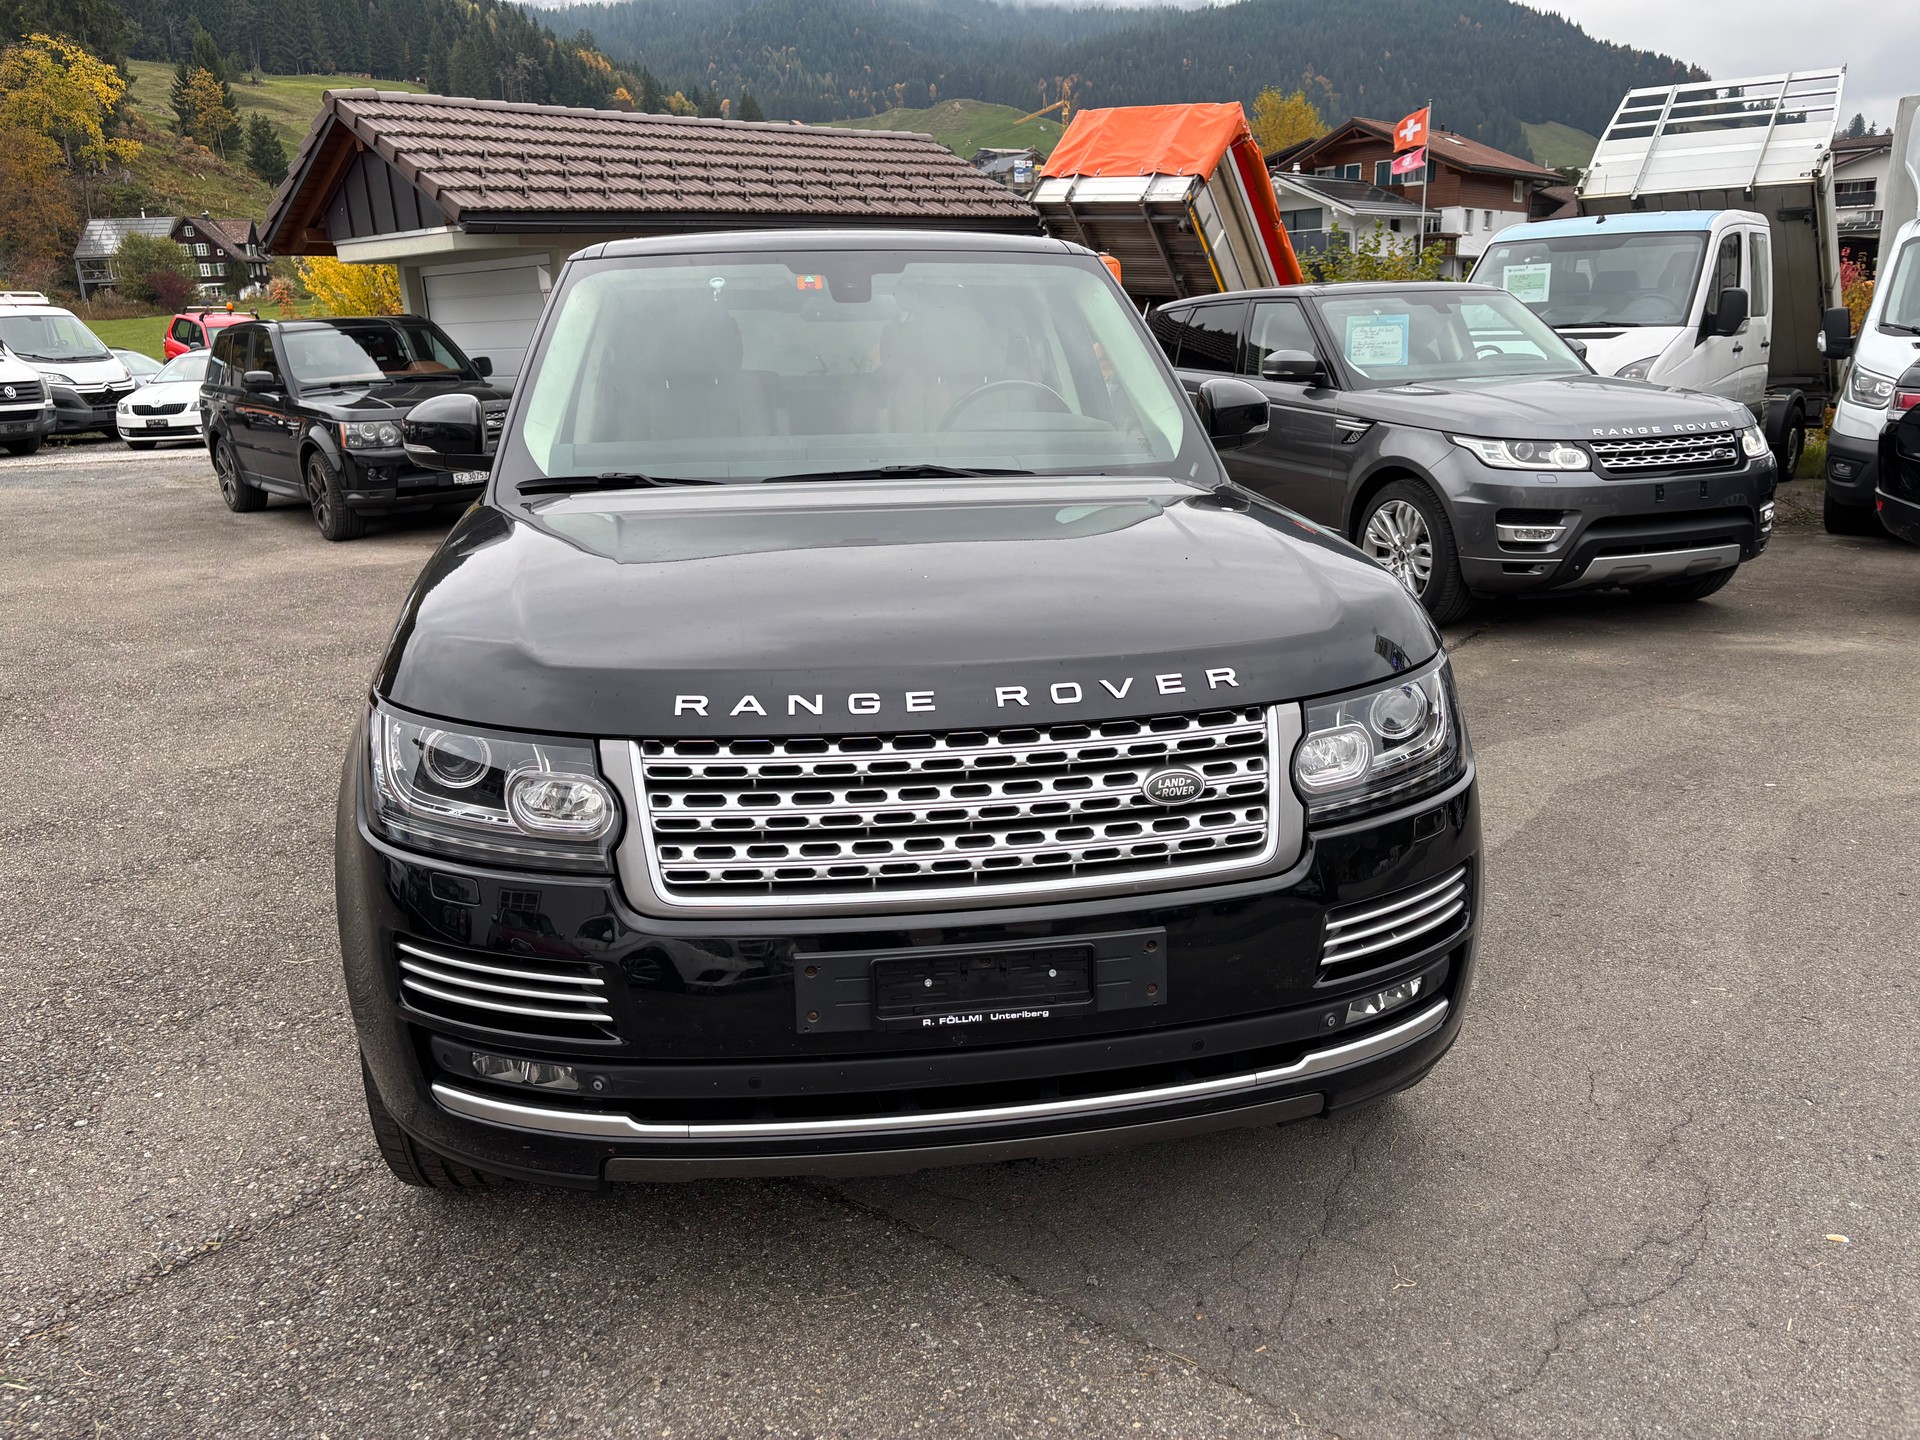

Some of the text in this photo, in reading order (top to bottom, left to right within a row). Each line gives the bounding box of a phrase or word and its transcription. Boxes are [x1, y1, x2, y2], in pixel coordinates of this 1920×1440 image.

[1592, 420, 1730, 437] RANGE ROVER
[674, 667, 1240, 716] RANGE ROVER
[1157, 777, 1186, 789] LAND
[1161, 785, 1195, 798] ROVER
[922, 1009, 1050, 1027] R. FÖLLMI Unteriberg
